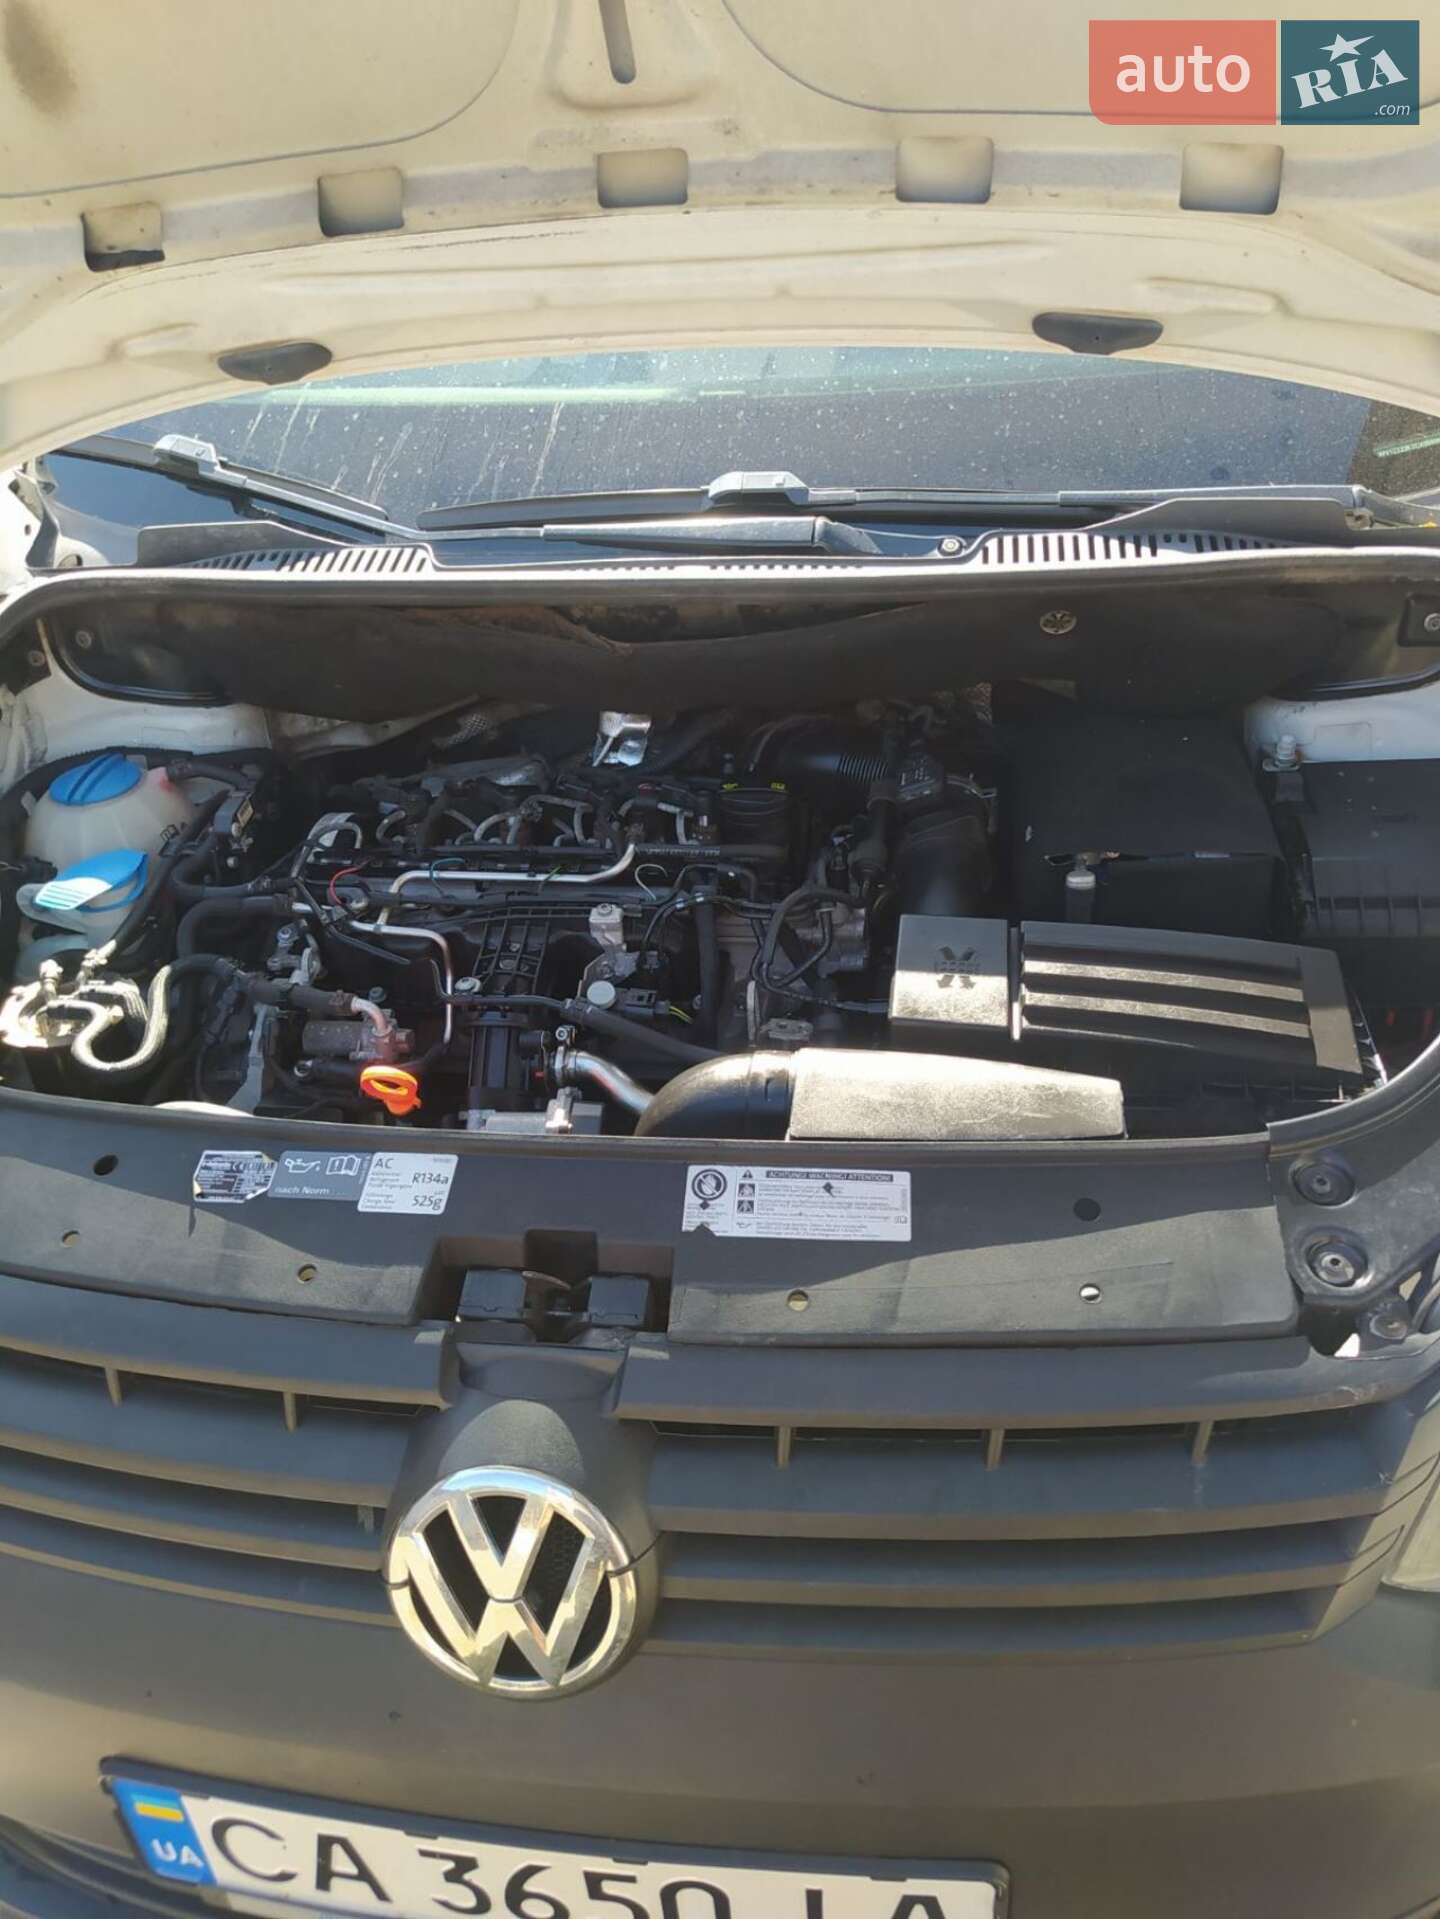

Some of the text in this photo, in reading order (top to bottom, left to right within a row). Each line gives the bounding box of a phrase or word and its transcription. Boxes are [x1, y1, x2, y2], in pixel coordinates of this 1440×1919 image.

[374, 1157, 395, 1170] AC
[411, 1172, 450, 1185] R134a
[301, 1186, 331, 1195] Norm
[411, 1194, 443, 1211] 525g
[151, 1839, 204, 1868] UA
[210, 1817, 393, 1903] CA
